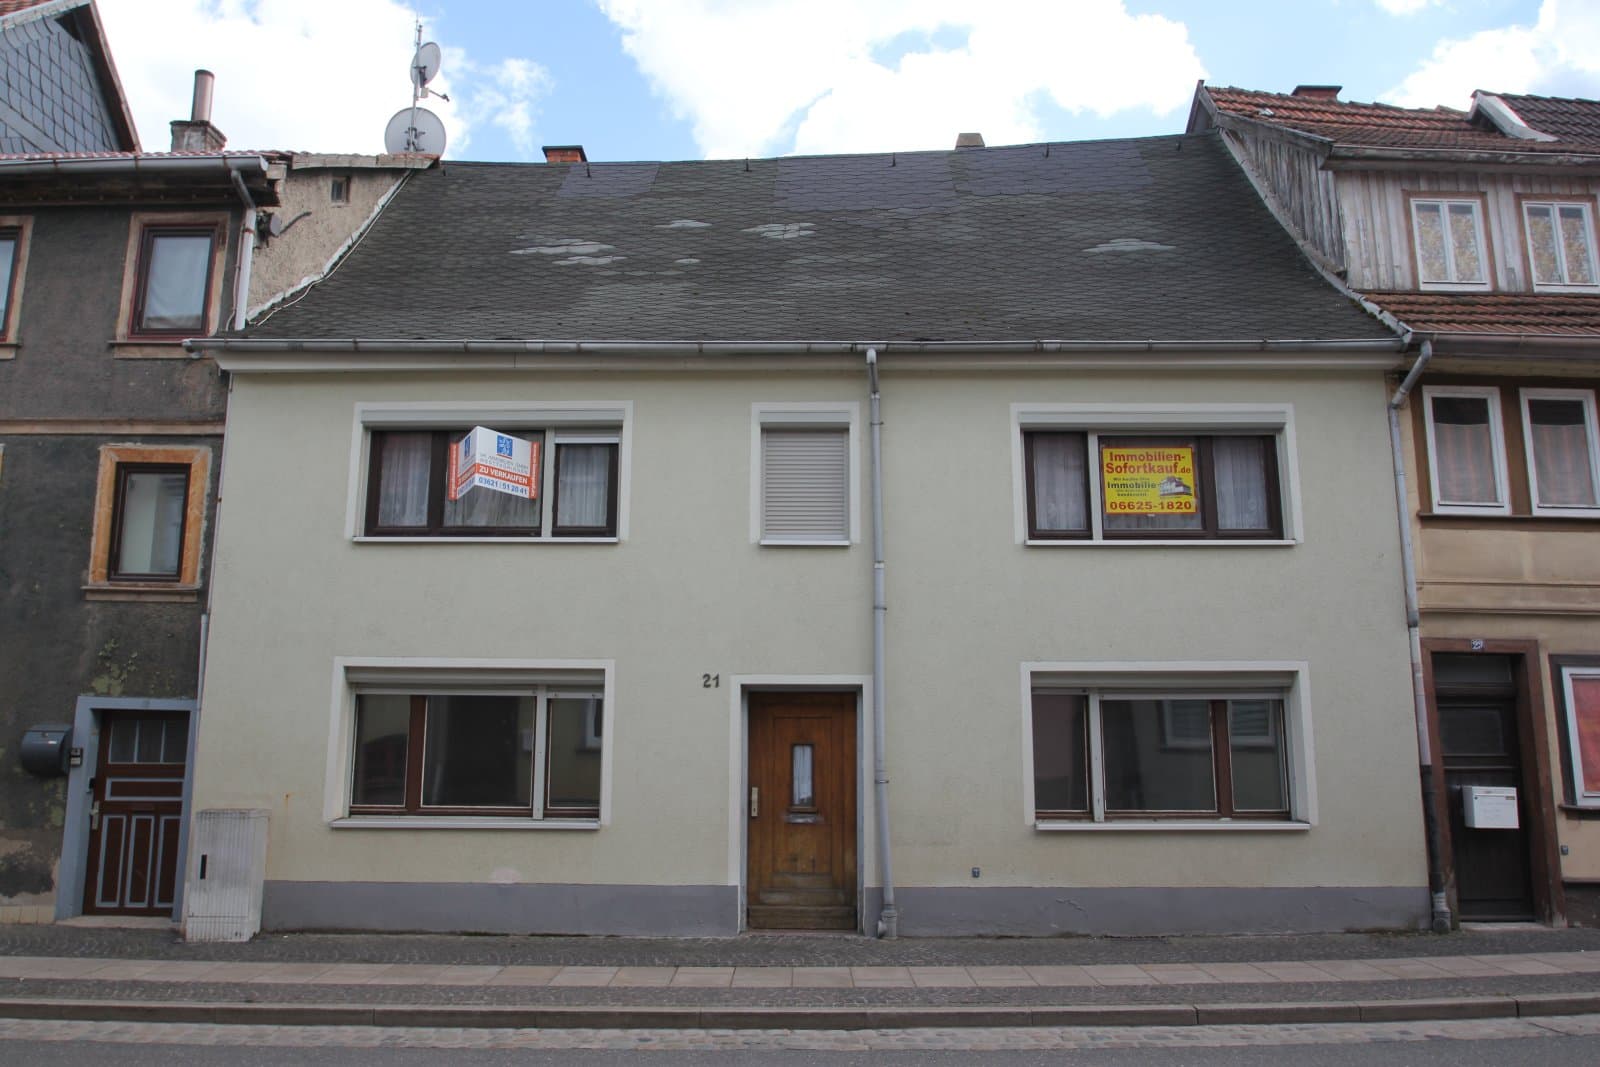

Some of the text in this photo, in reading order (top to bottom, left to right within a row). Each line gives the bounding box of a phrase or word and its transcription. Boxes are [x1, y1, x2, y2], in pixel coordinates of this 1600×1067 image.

[1109, 452, 1186, 462] Immobilien-
[1106, 462, 1191, 474] Sofortkauf.de
[479, 465, 489, 474] ZU
[490, 467, 528, 484] VERKAUFEN
[478, 477, 498, 488] 03621
[502, 482, 510, 490] 51
[519, 487, 527, 495] 41
[1107, 481, 1156, 489] Immobilie
[1110, 501, 1191, 510] 06625-1820
[702, 673, 720, 688] 21
